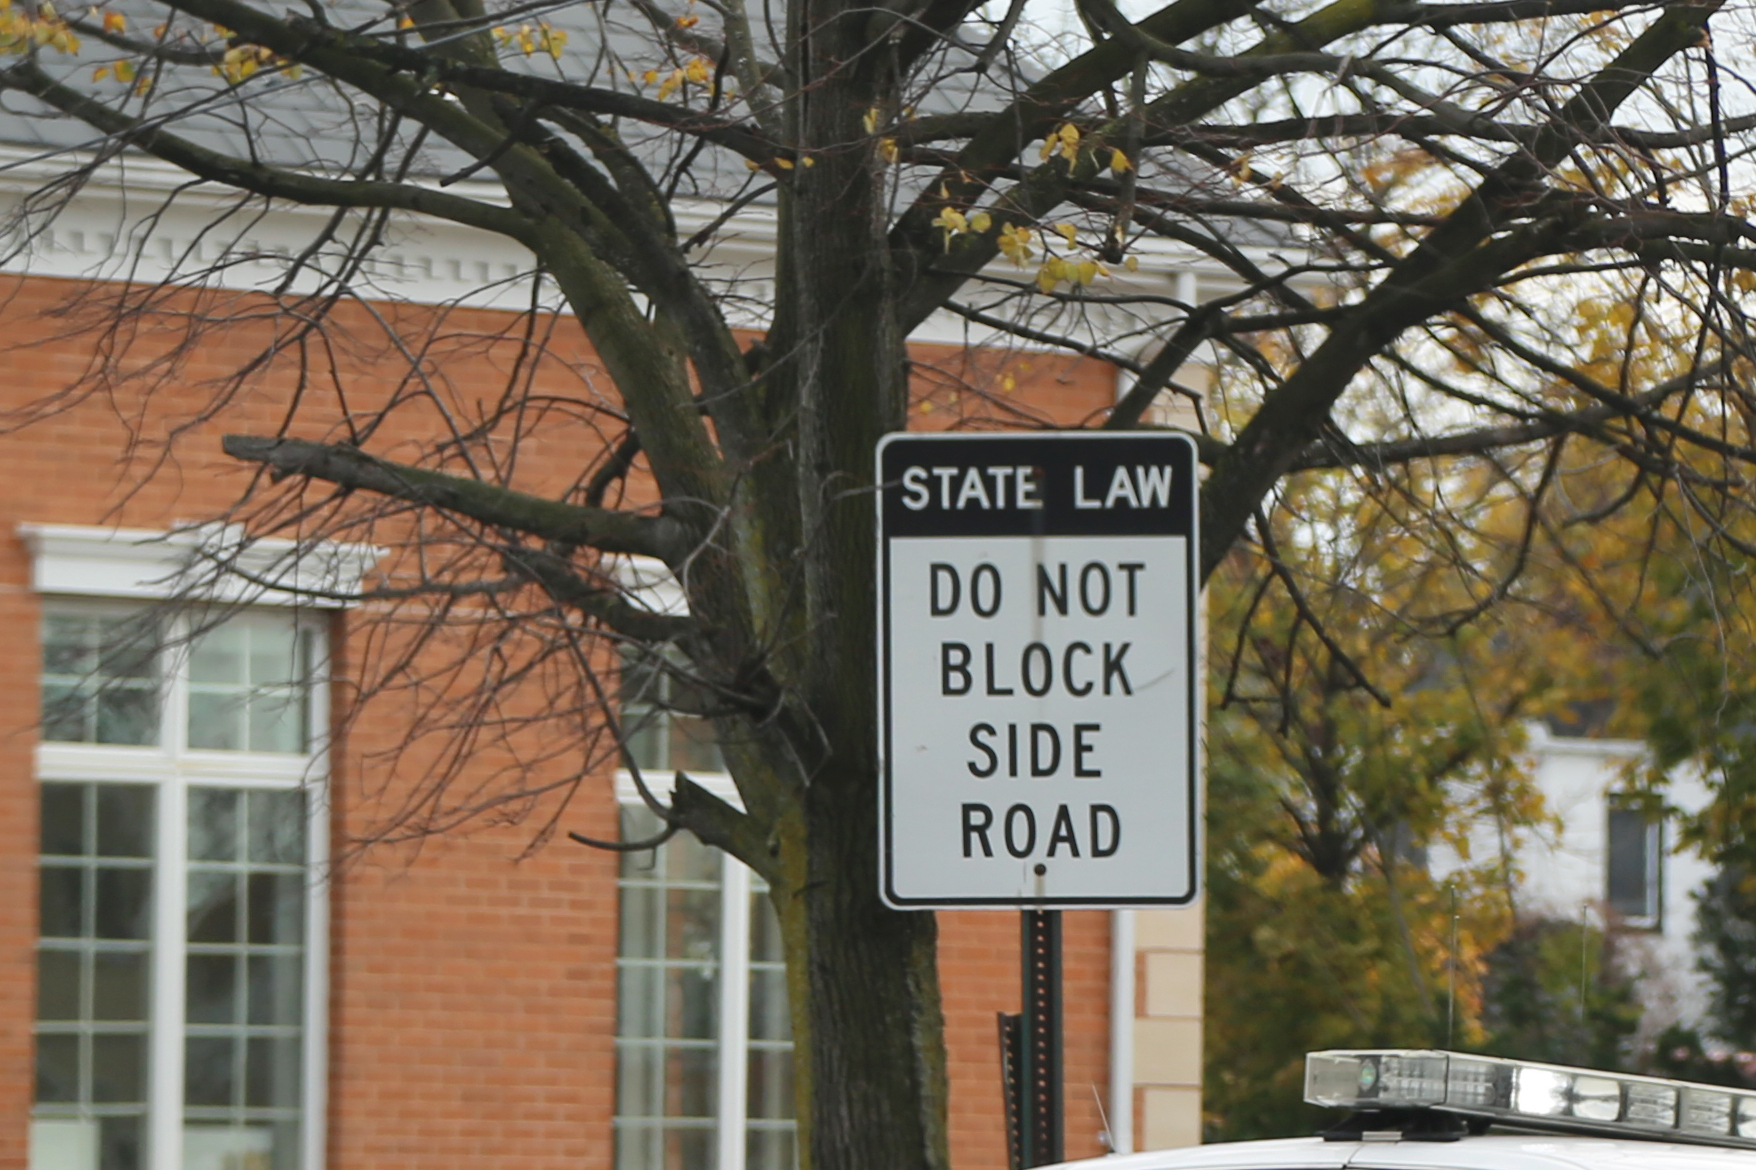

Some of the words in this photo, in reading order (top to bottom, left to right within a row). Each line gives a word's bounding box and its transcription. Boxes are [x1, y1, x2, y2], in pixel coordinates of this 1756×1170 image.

[901, 465, 1044, 511] STATE
[1073, 465, 1174, 510] LAW
[930, 562, 1000, 617] DO
[1037, 562, 1145, 617] NOT
[941, 641, 1132, 697] BLOCK
[967, 723, 1102, 778] SIDE
[962, 803, 1121, 858] ROAD
